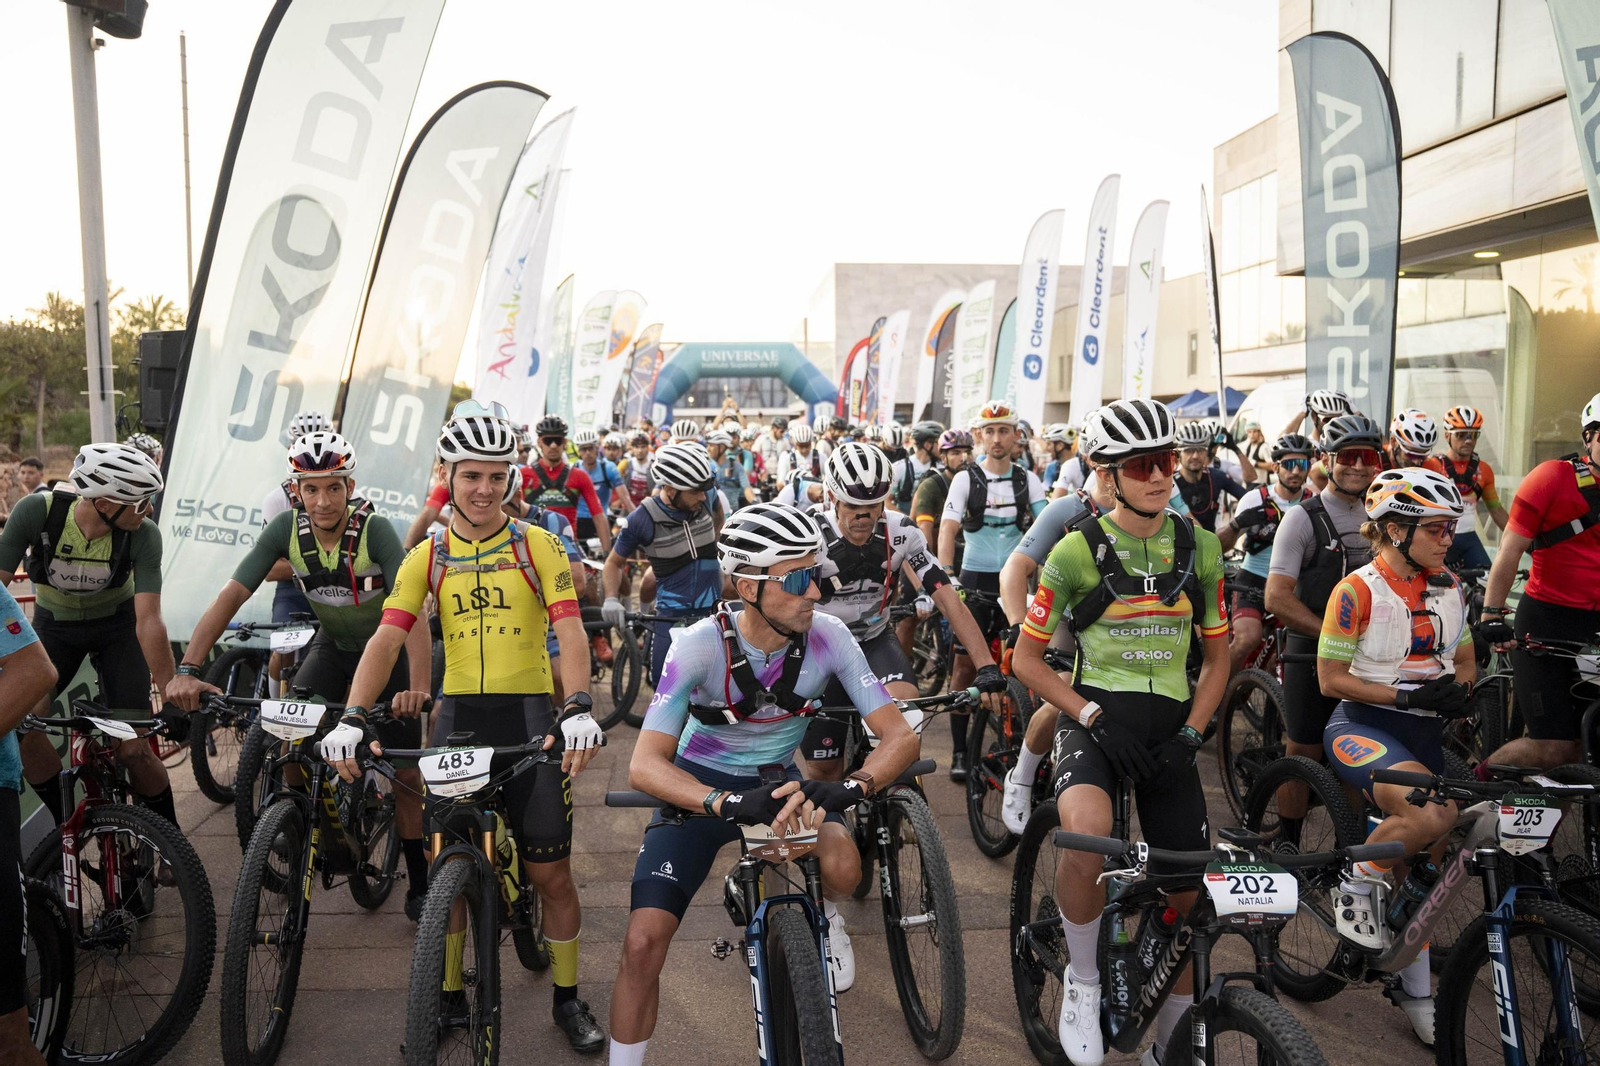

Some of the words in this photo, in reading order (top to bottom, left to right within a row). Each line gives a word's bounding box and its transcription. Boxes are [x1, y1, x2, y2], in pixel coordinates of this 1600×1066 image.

[1089, 226, 1107, 330] Cleardent
[1030, 256, 1049, 350] Cleardent
[701, 350, 779, 361] UNIVERSAE
[1389, 502, 1424, 514] catlike
[172, 525, 193, 538] We
[285, 632, 301, 641] 23
[449, 626, 522, 642] FASTER
[1109, 624, 1178, 638] ecopilas
[1121, 649, 1174, 661] GR-100
[280, 703, 307, 716] 101
[813, 748, 839, 759] BH
[438, 751, 475, 771] 483
[446, 769, 470, 779] DANIEL
[1513, 809, 1545, 826] 203
[1226, 875, 1278, 894] 202
[1238, 897, 1274, 905] NATALIA
